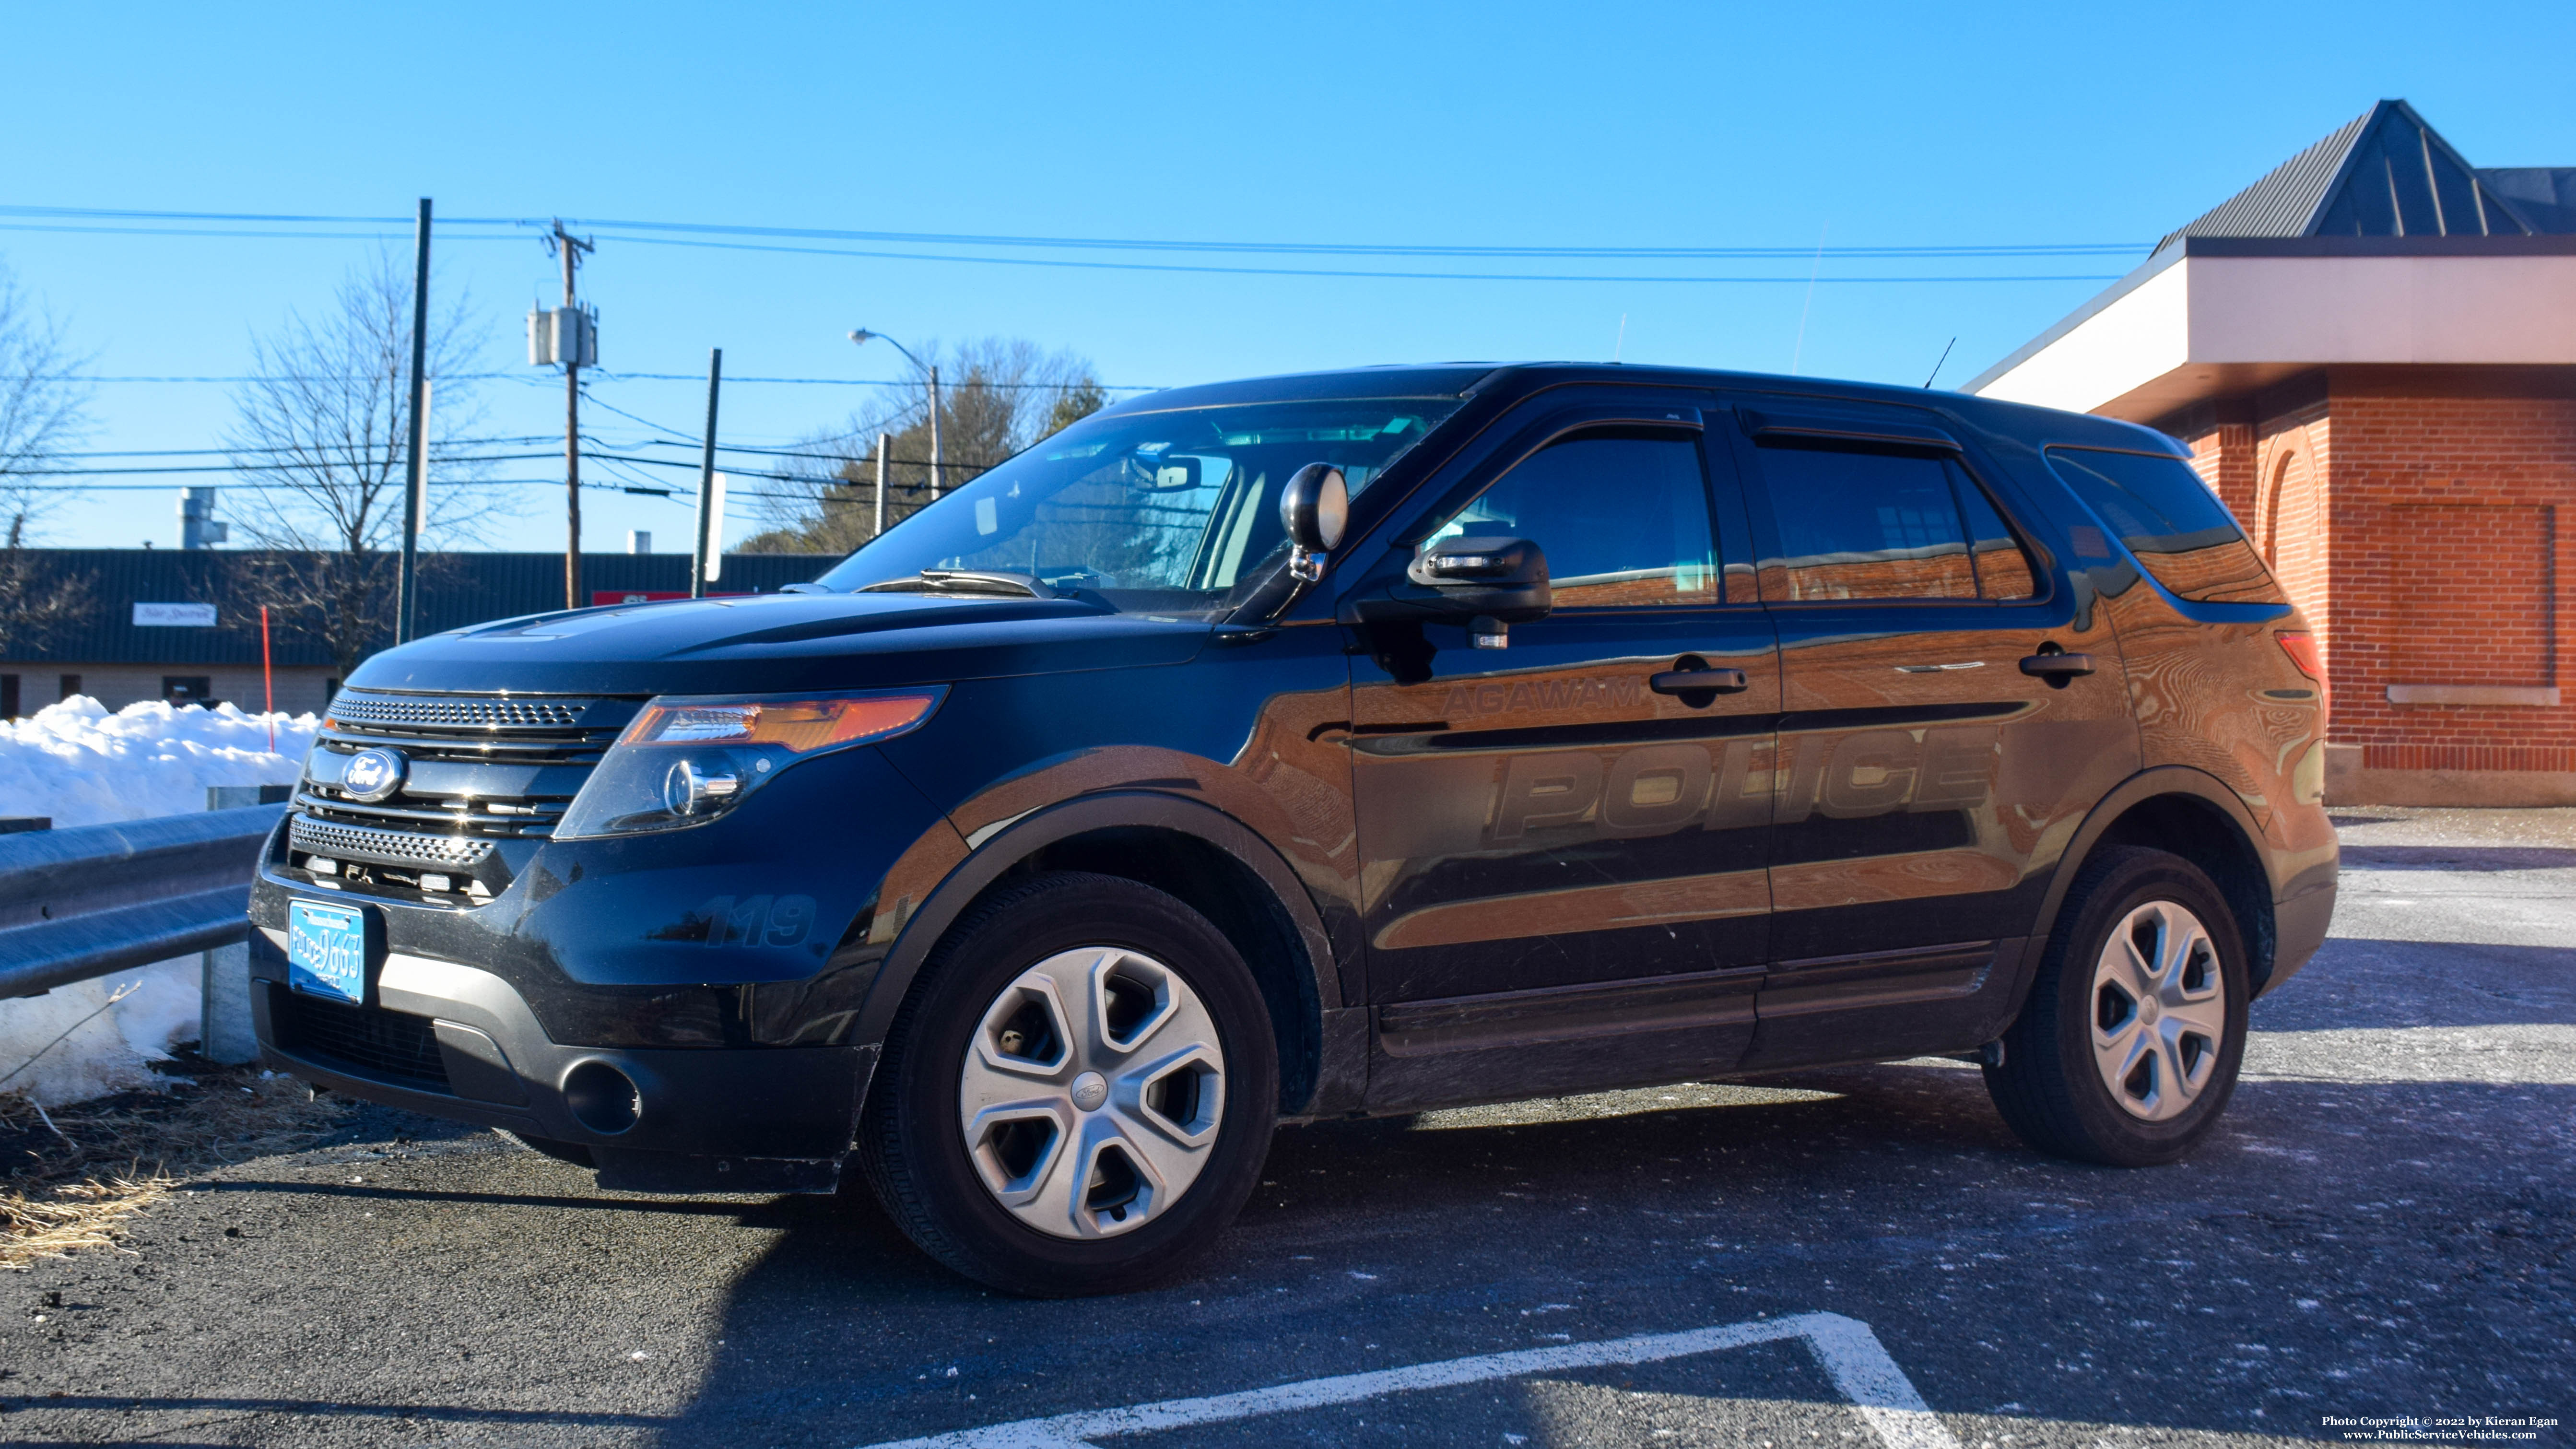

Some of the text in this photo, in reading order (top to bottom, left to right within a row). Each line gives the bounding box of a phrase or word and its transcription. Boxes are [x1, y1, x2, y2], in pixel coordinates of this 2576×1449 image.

[1440, 675, 1641, 719] AGAWAM
[348, 756, 382, 786] Ford
[1481, 724, 2000, 848] POLICE
[694, 894, 817, 948] 119
[319, 929, 360, 978] 9663
[1082, 1086, 1100, 1098] Ford
